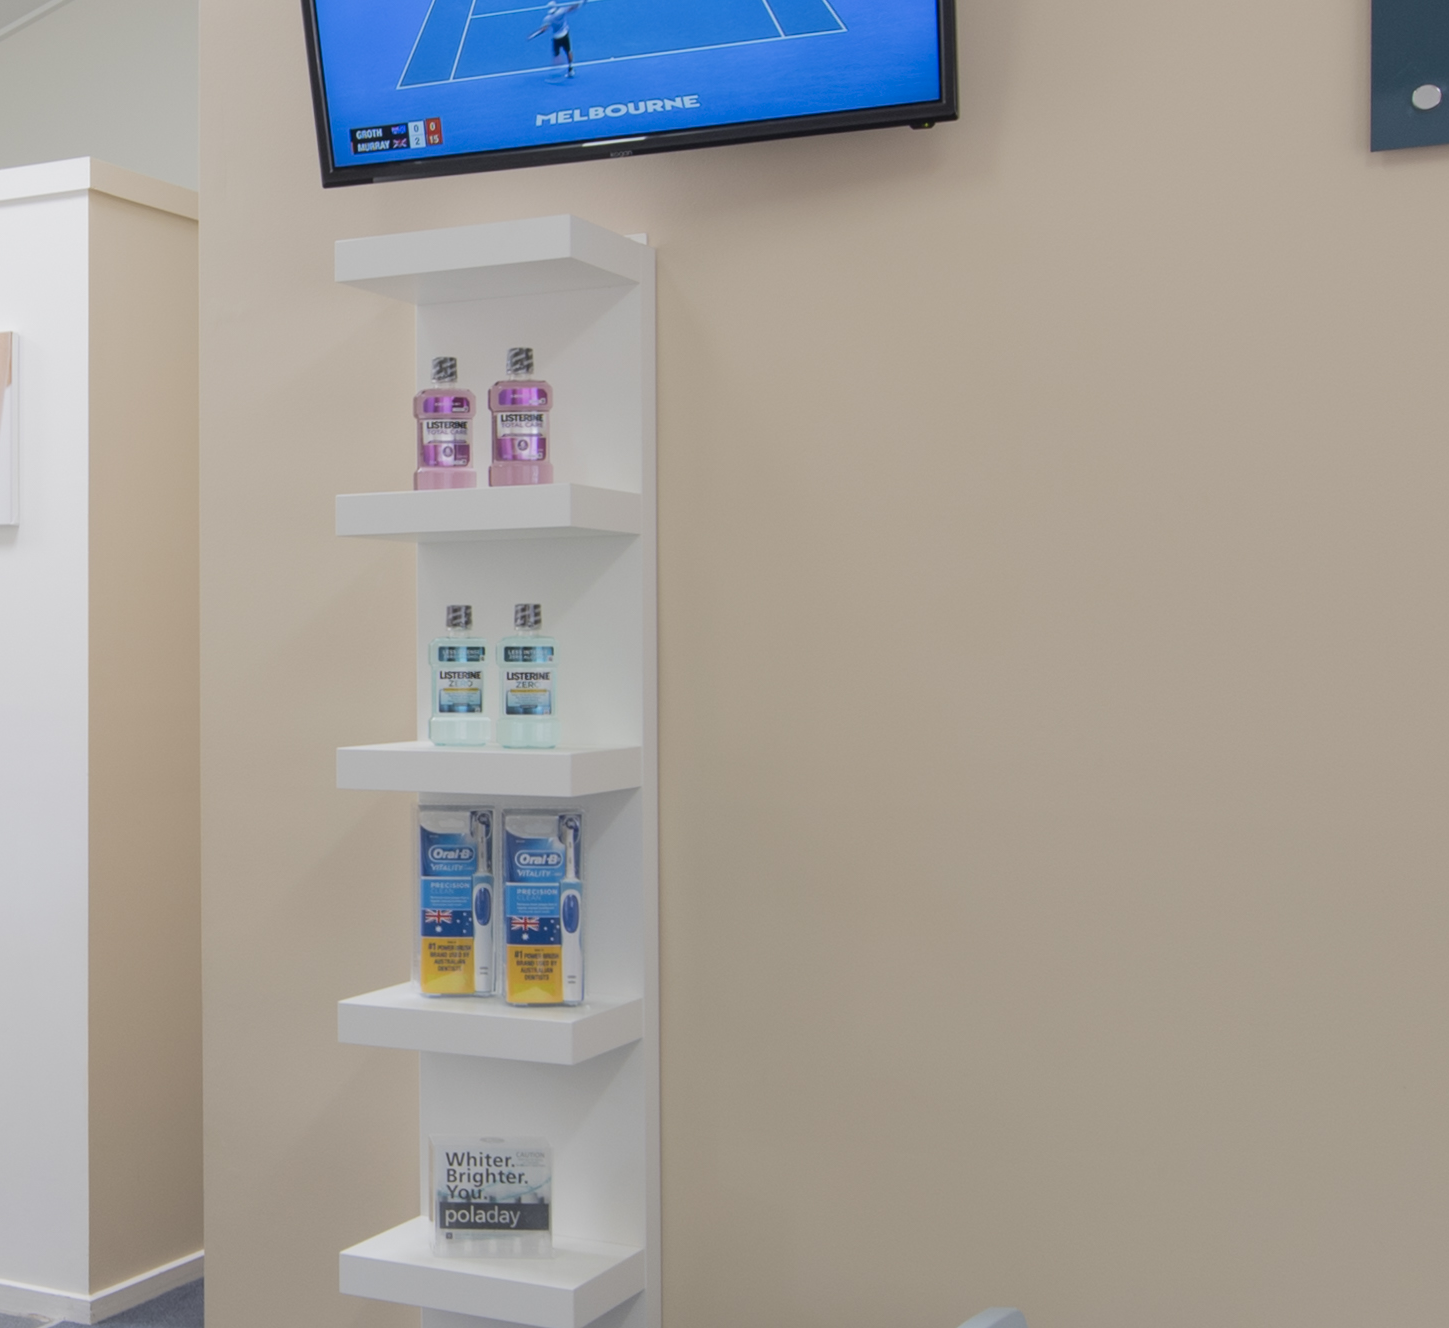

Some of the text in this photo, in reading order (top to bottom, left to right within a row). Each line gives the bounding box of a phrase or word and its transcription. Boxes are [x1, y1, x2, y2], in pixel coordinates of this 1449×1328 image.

[535, 94, 701, 127] MELBOURNE
[356, 128, 383, 140] GROTH
[357, 140, 390, 152] MURRAY
[429, 135, 439, 144] 15
[500, 414, 544, 422] LISTERINE
[426, 421, 468, 429] LISTERINE
[439, 671, 482, 680] LISTERINE
[506, 672, 550, 681] LISTERINE
[516, 680, 542, 688] ZERO
[432, 848, 471, 859] Oral-B
[519, 853, 559, 865] Oral-B
[516, 869, 551, 877] VITALITY
[445, 1151, 515, 1168] Whiter.
[446, 1168, 529, 1188] Brighter.
[446, 1184, 488, 1200] You.
[445, 1205, 521, 1228] poladay
